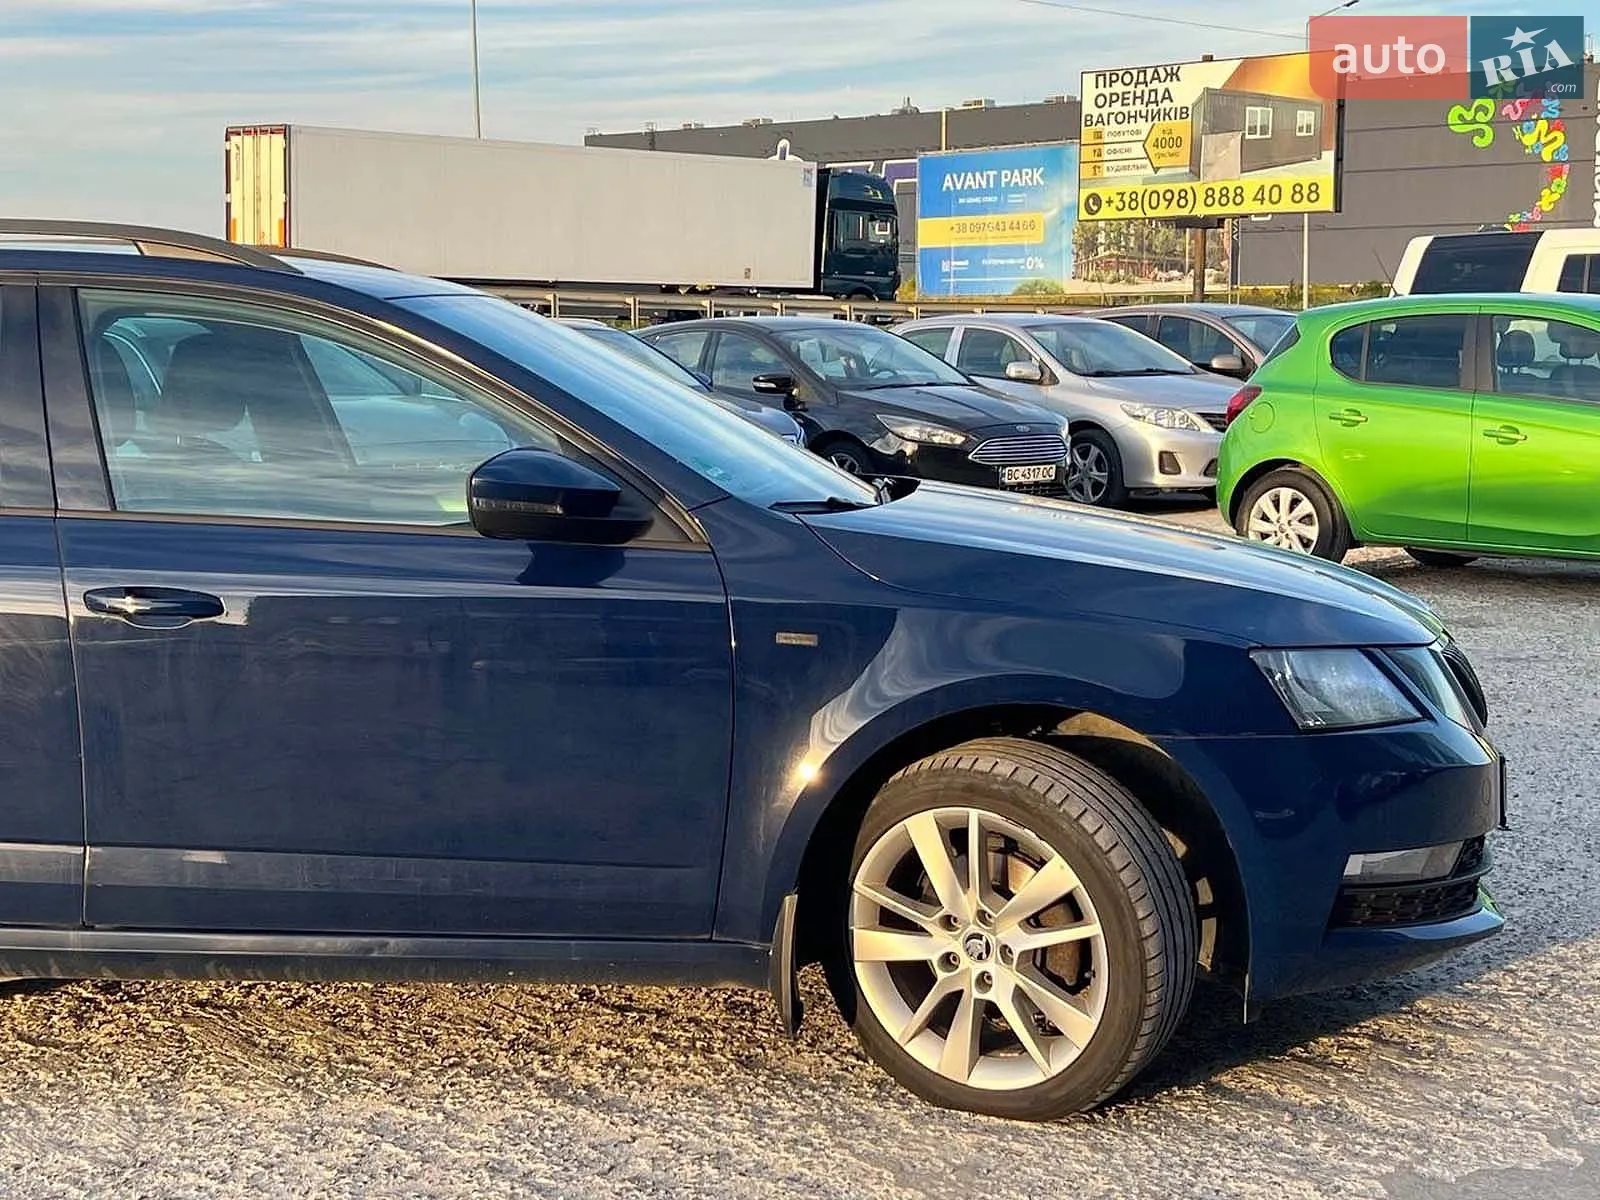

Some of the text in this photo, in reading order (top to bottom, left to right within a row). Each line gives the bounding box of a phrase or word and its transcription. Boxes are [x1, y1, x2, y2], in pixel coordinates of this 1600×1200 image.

[1095, 66, 1181, 89] ПРОДАЖ
[1094, 88, 1174, 108] ОРЕНДА
[1084, 106, 1190, 127] ВАГОНЧИКІВ
[1152, 136, 1183, 149] 4000
[942, 167, 1045, 191] AVANT PARK
[1105, 182, 1321, 216] +38(098) 888 40 88
[1007, 468, 1020, 480] BC
[1021, 467, 1040, 479] 4317
